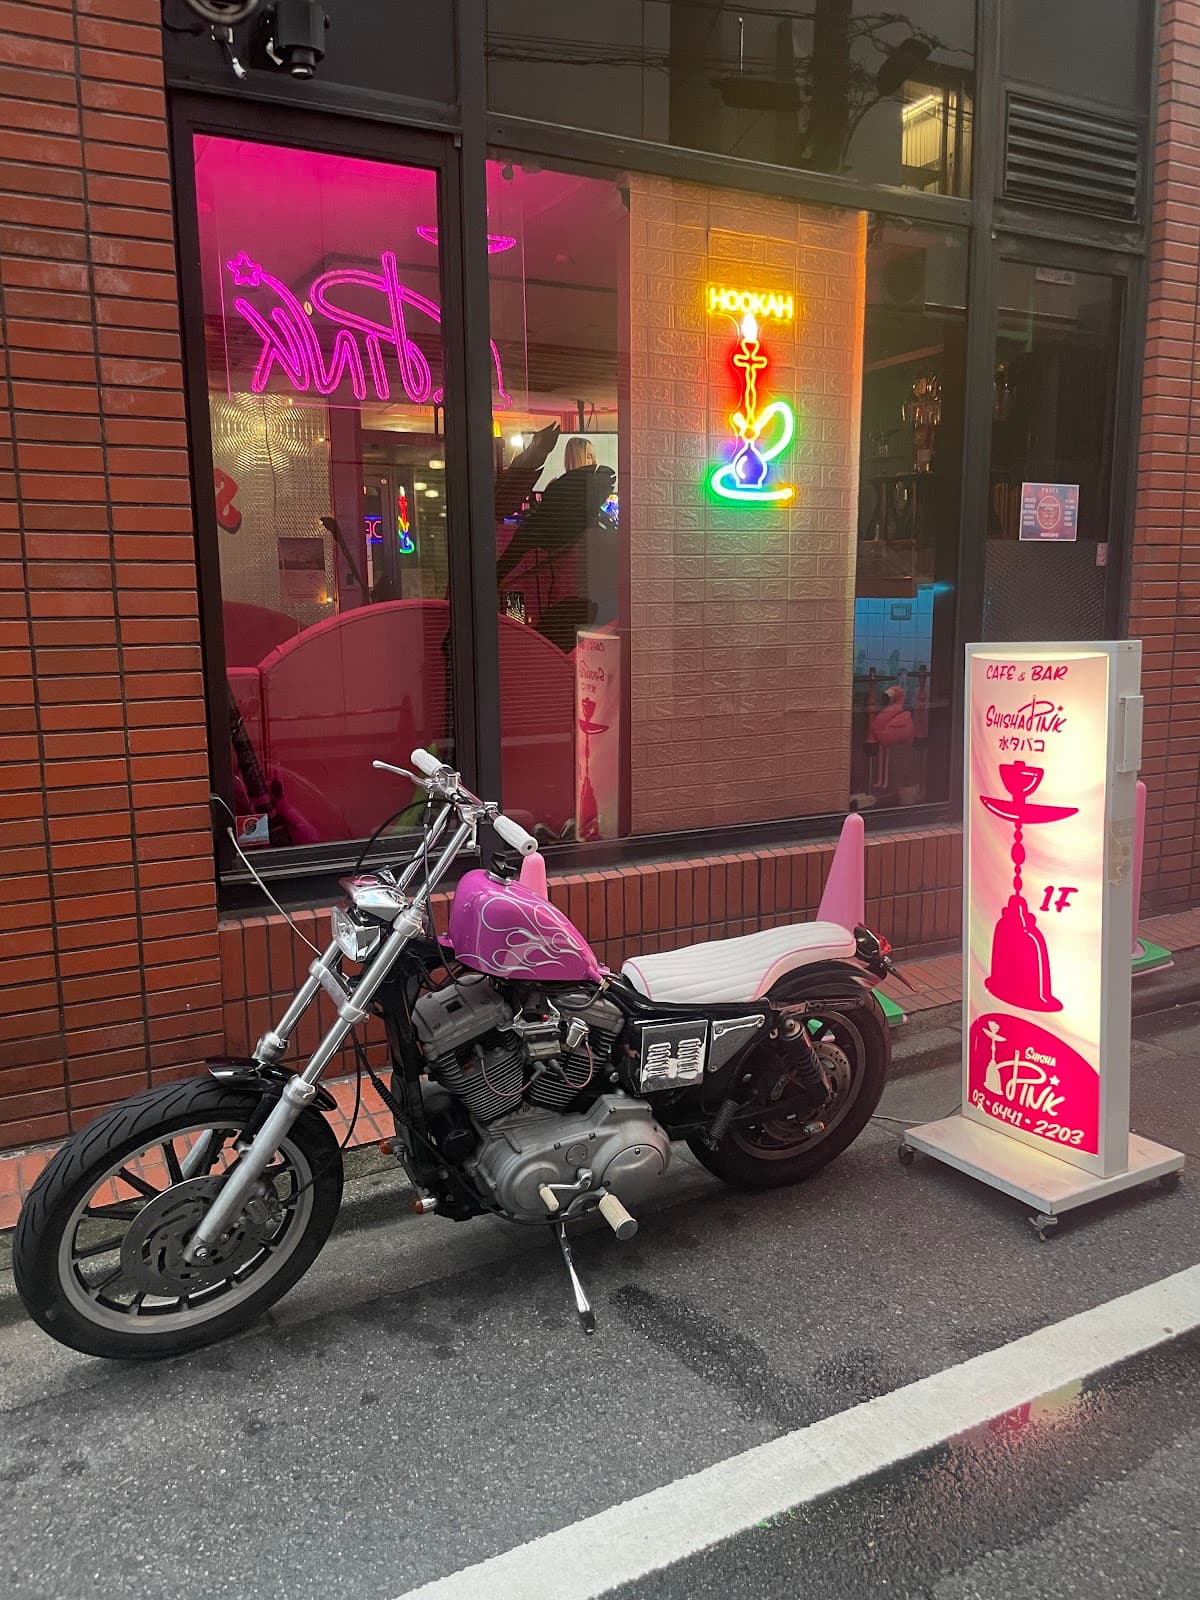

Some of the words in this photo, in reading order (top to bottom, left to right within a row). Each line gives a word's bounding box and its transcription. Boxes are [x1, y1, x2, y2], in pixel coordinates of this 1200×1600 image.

[709, 287, 793, 319] HOOKAH
[986, 665, 1016, 680] CAFE
[1018, 671, 1026, 682] &
[1031, 665, 1068, 681] BAR
[999, 736, 1045, 752] 水タバコ
[1039, 885, 1078, 913] 1F
[996, 1049, 1066, 1117] PINK
